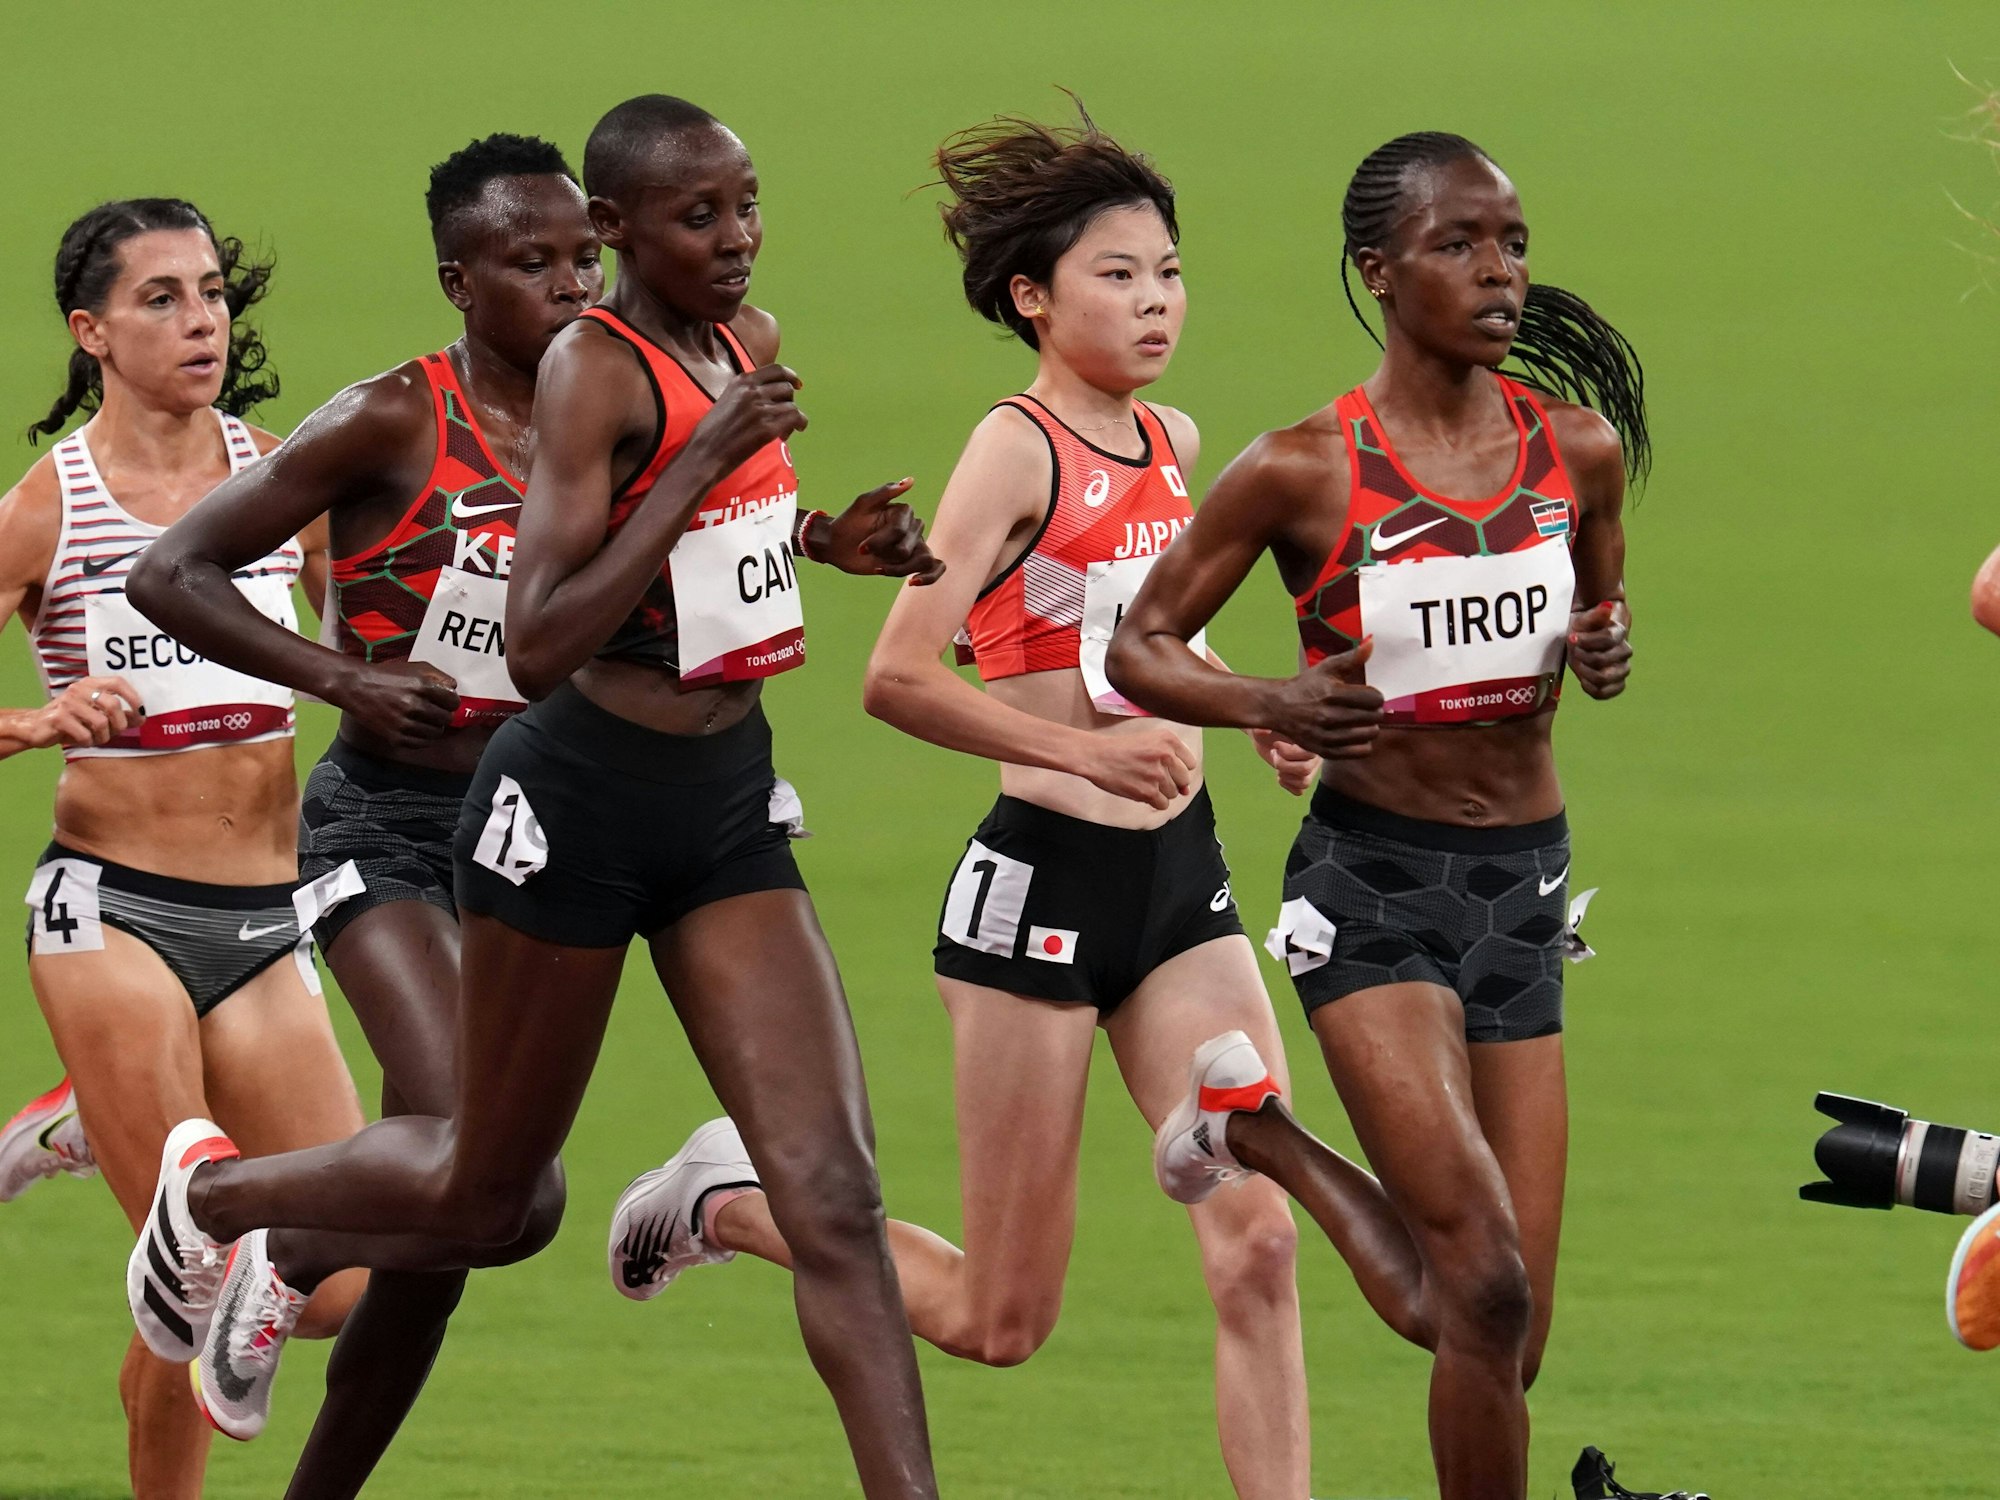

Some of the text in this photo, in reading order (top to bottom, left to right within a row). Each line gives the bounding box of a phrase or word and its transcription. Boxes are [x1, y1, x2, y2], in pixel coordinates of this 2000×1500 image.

[452, 528, 516, 576] KE
[1114, 516, 1195, 559] JAPA
[437, 610, 506, 657] REN
[1411, 584, 1548, 648] TIROP
[746, 645, 795, 667] TOKYO 2020
[1439, 693, 1504, 710] TOKYO 2020
[161, 718, 221, 735] TOKYO 2020
[43, 866, 79, 944] 4
[966, 859, 998, 940] 1
